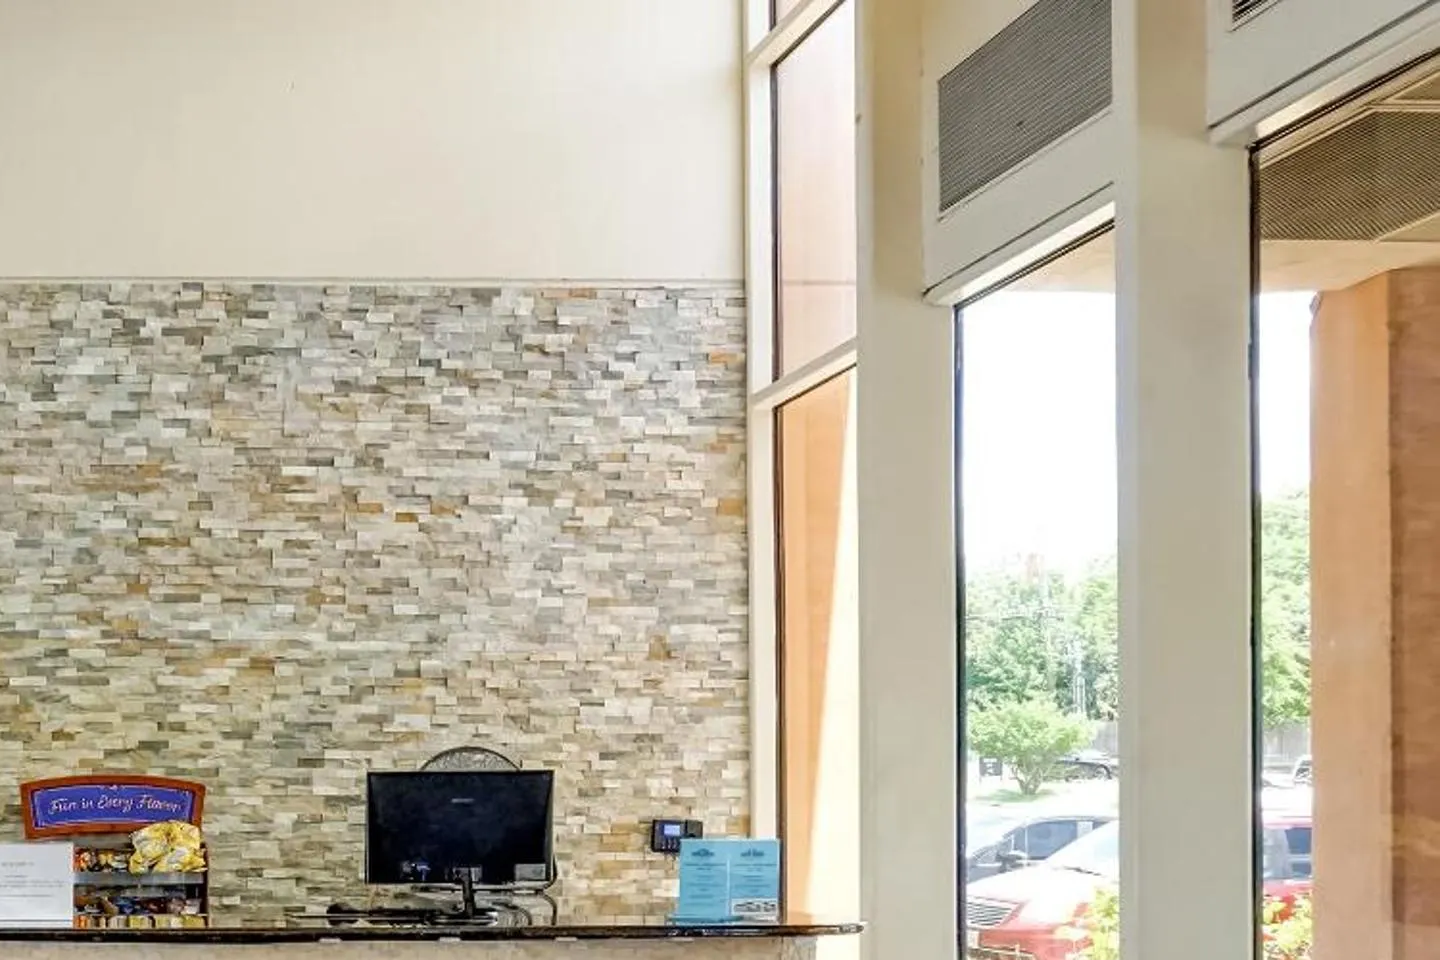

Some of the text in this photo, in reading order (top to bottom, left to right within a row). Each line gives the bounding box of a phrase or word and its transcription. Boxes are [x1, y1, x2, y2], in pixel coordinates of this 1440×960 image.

[48, 799, 76, 814] Fun
[81, 797, 93, 809] in
[97, 795, 133, 813] Every
